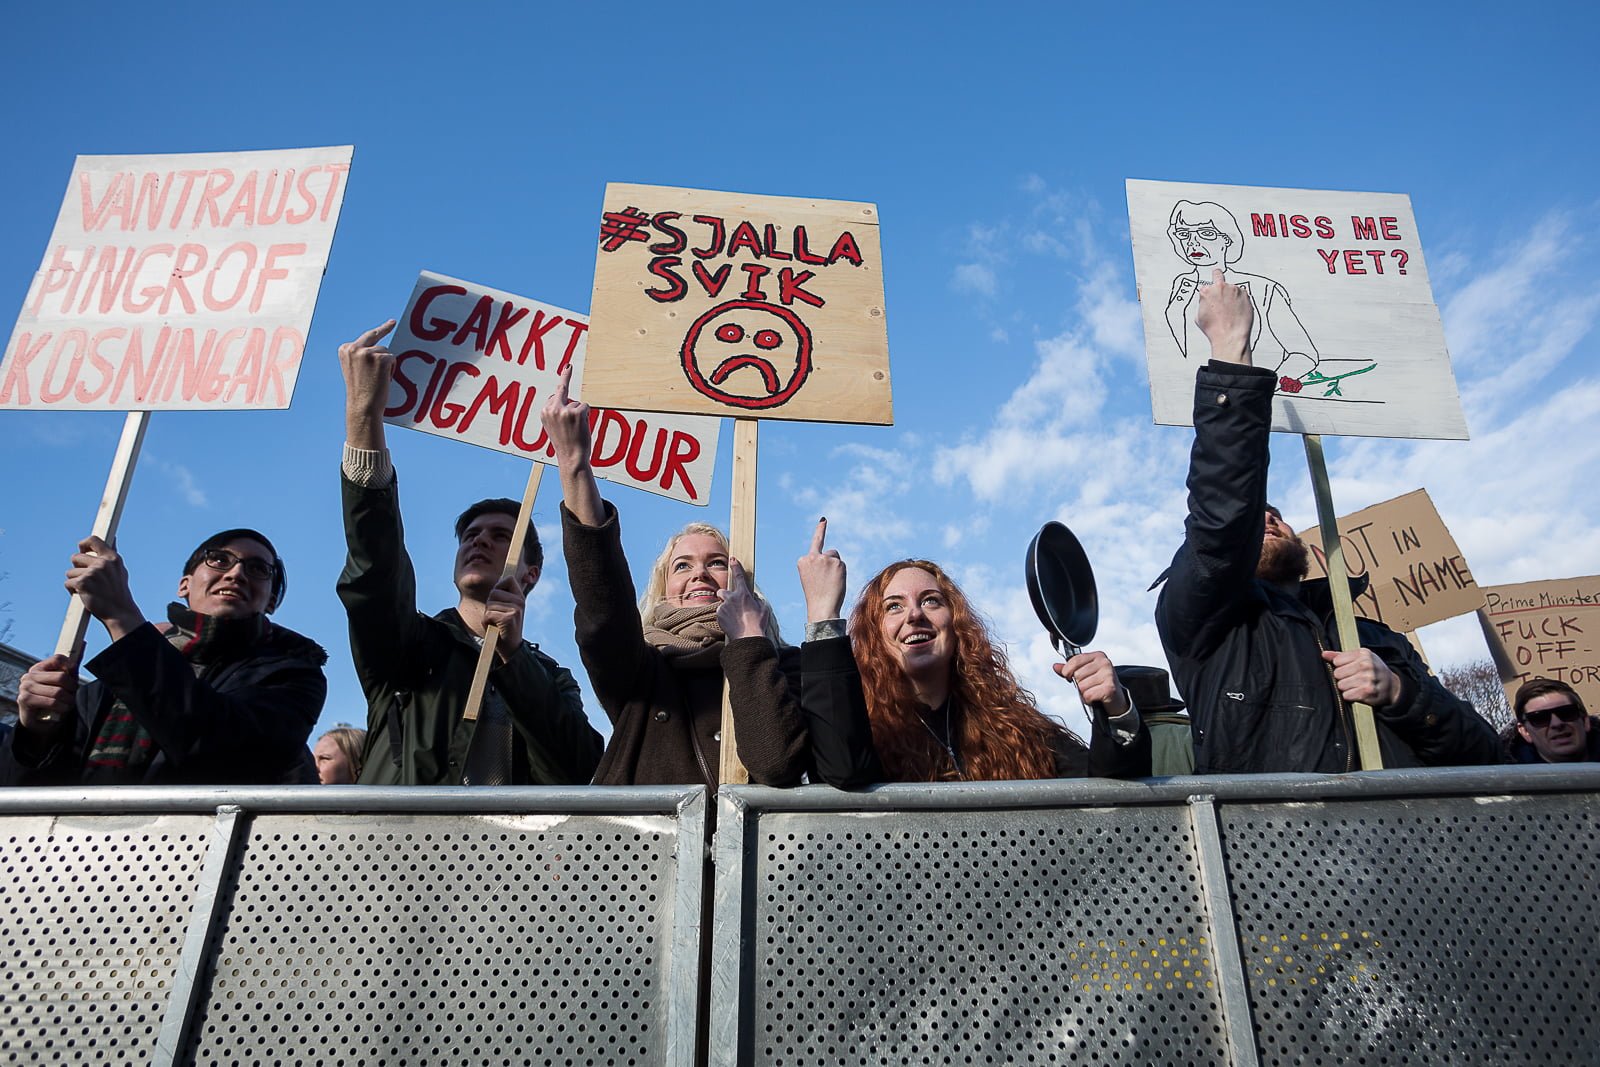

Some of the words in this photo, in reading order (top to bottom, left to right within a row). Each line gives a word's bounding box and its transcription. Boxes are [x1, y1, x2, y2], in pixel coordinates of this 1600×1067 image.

[78, 163, 350, 232] VANTRAUST
[600, 206, 863, 267] #SJALLA
[1251, 212, 1335, 239] MISS
[1351, 215, 1402, 241] ME
[1317, 248, 1409, 276] YET?
[644, 256, 826, 309] SVIK
[410, 285, 589, 376] GAKKT
[0, 326, 304, 408] KOSNINGAR
[383, 349, 701, 500] SIGMUDUR
[1392, 526, 1422, 555] IN
[1392, 555, 1474, 607] NAME
[1486, 592, 1535, 613] Prime
[1495, 615, 1584, 643] FUCK
[1516, 640, 1576, 666] OFF
[1547, 665, 1600, 684] TOR
